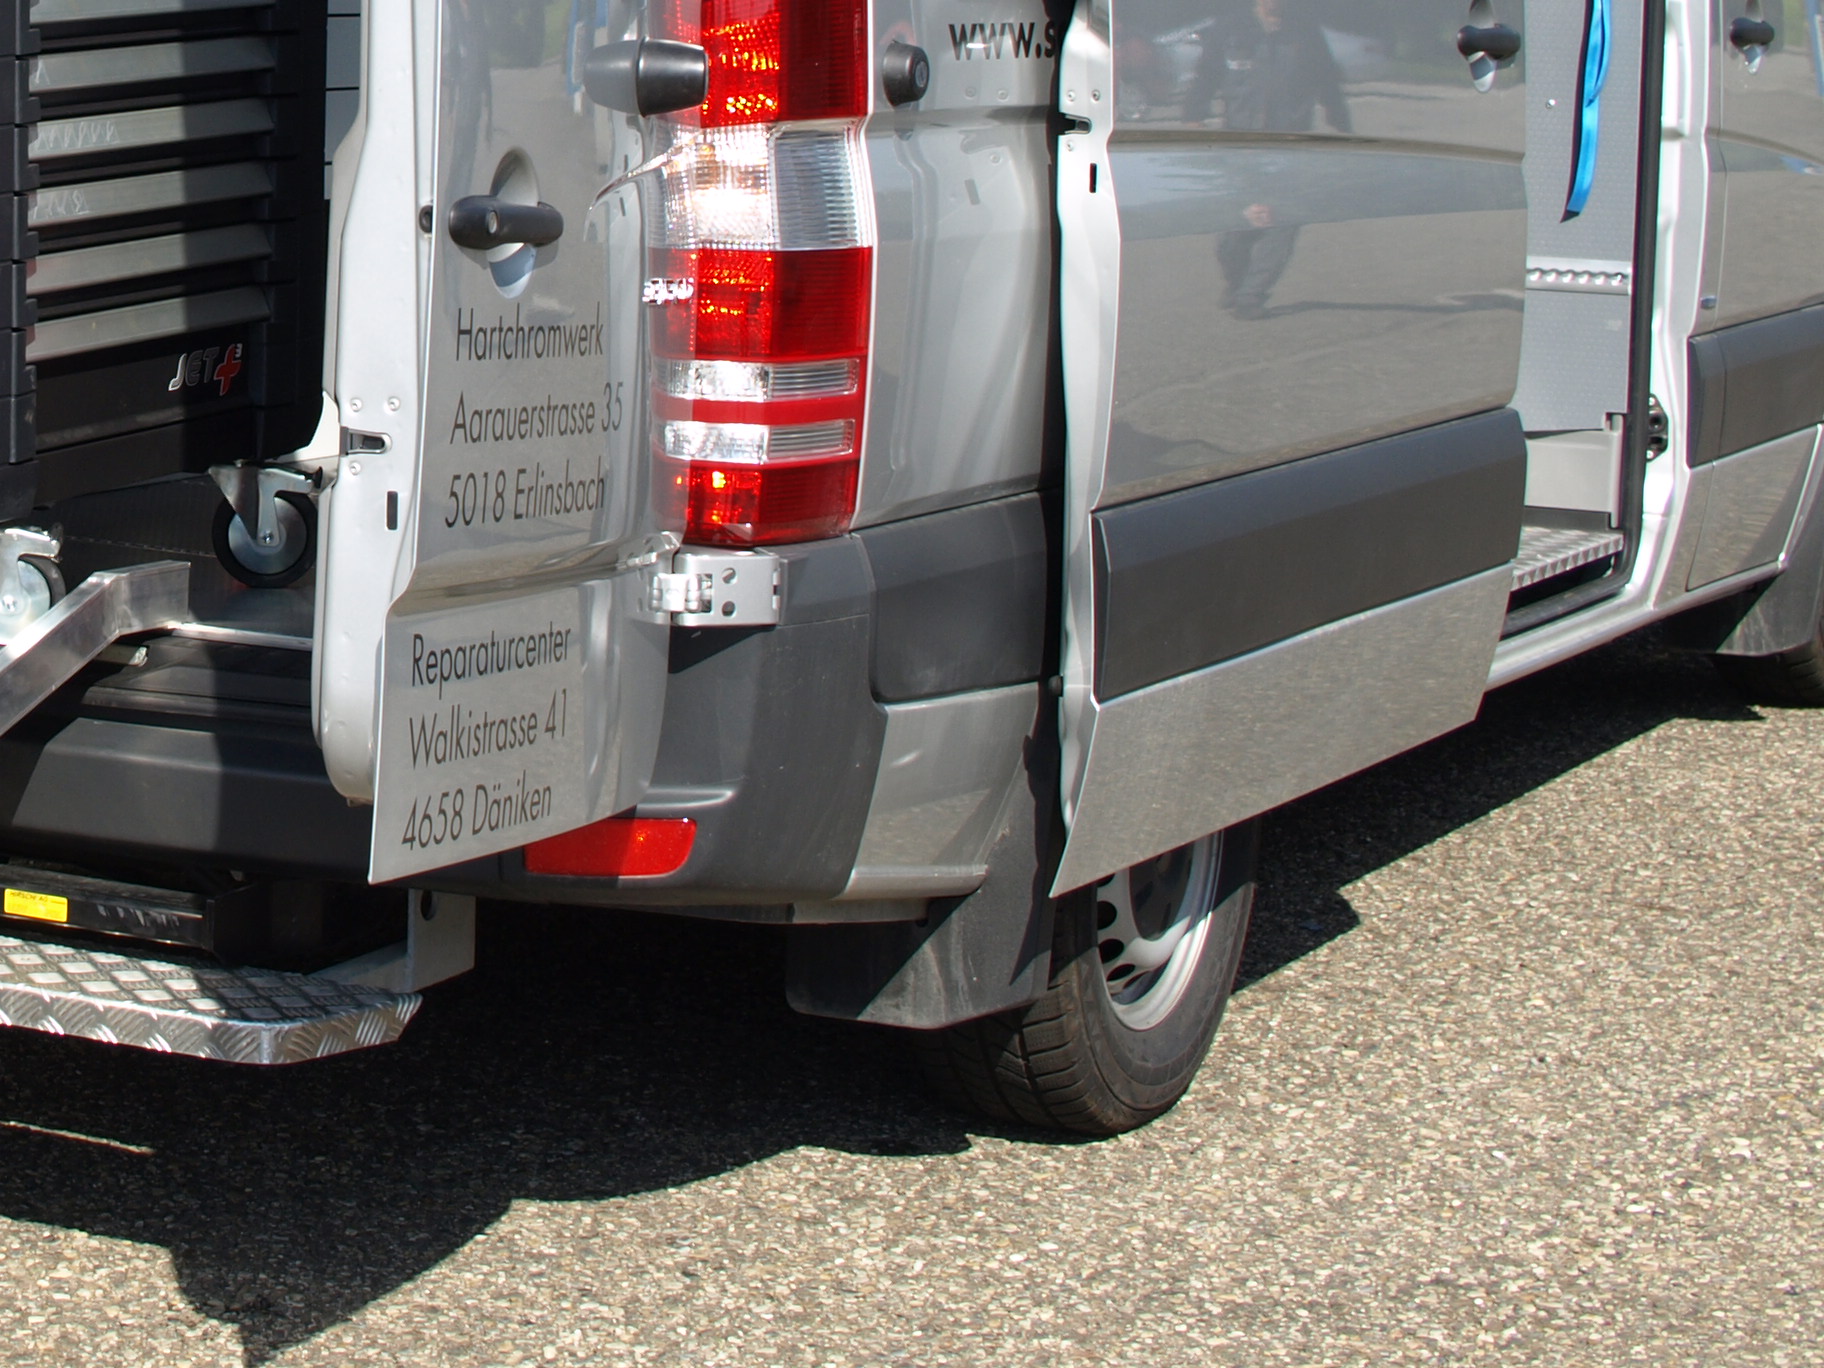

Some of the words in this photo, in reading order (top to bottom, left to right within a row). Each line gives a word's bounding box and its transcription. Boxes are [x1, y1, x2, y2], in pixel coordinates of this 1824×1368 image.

[455, 302, 604, 361] Hartchromwerk
[450, 393, 596, 445] Aarauerstrasse
[601, 382, 624, 431] 35
[445, 470, 506, 528] 5018
[513, 455, 605, 520] Erlinsbach
[412, 621, 571, 699] Reparaturcenter
[408, 704, 538, 770] Walkistrasse
[544, 688, 568, 739] 41
[401, 793, 464, 851] 4658
[471, 779, 552, 837] Däniken
